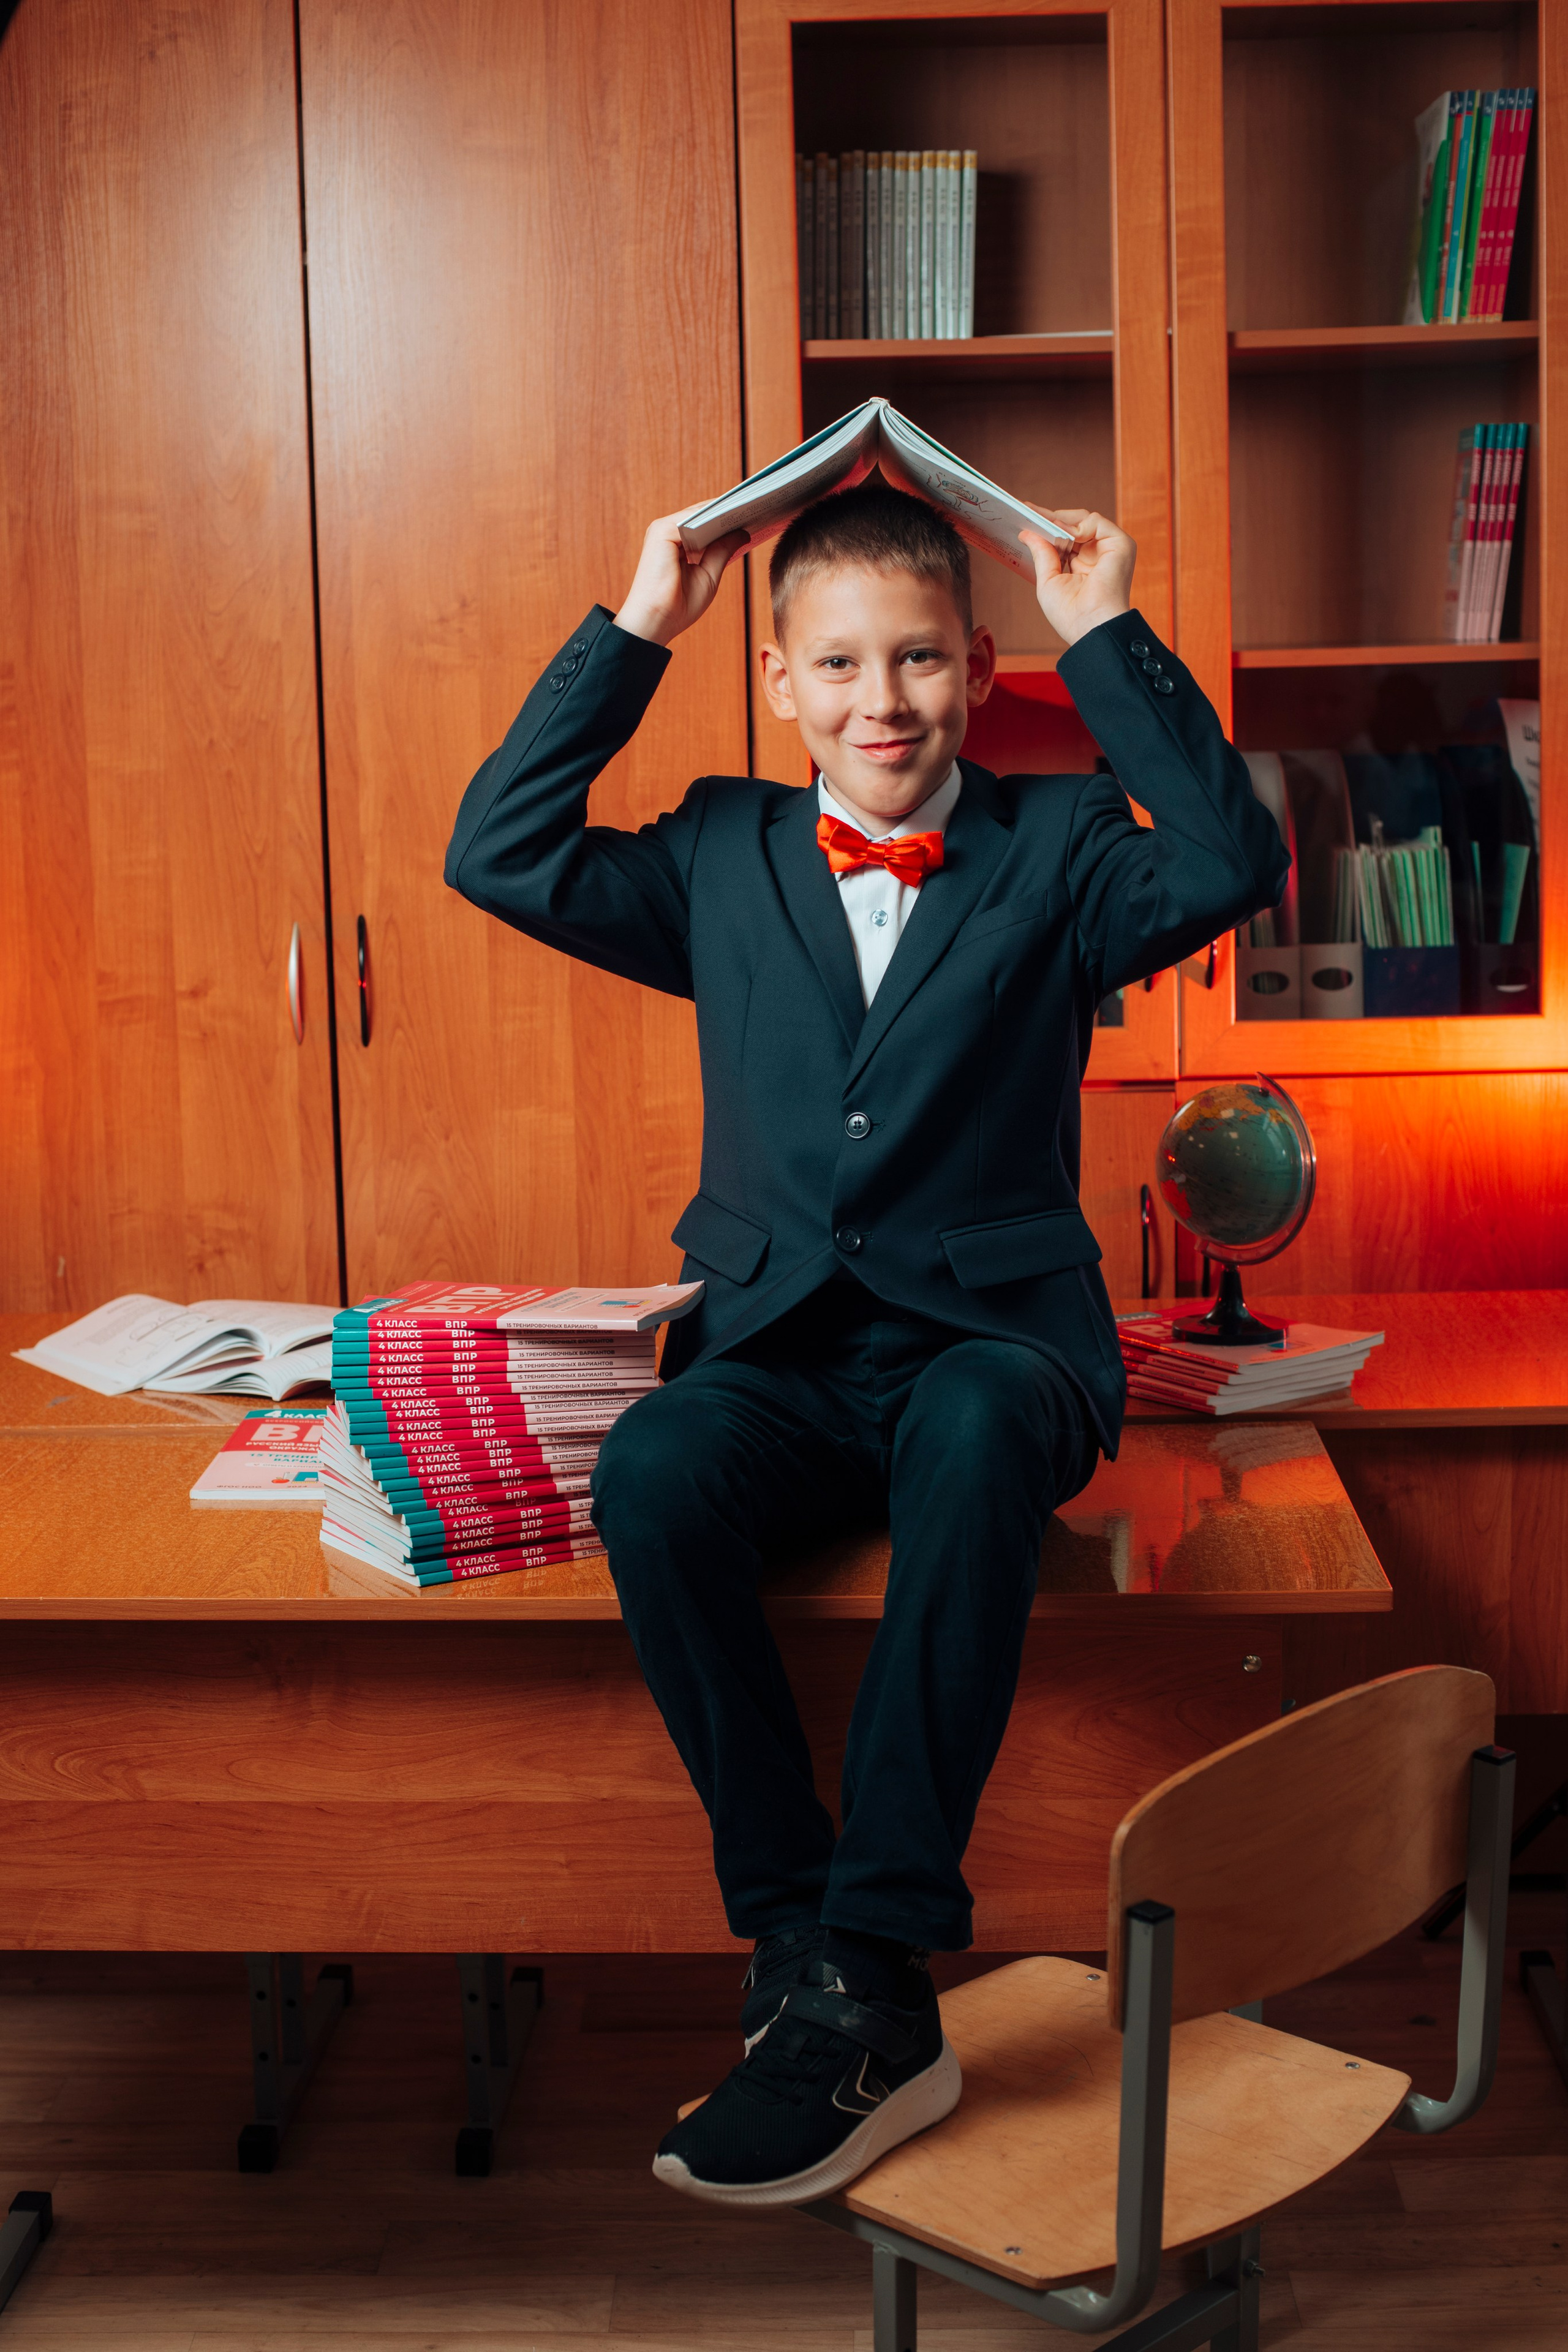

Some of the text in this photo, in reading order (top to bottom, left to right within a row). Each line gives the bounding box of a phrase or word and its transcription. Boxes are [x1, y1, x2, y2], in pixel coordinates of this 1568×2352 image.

[403, 1287, 516, 1313] ВПР
[388, 1354, 424, 1362] КЛАСС
[454, 1352, 477, 1361] ВПР
[387, 1377, 422, 1385] КЛАСС
[391, 1389, 427, 1397] КЛАСС
[401, 1400, 436, 1409] КЛАСС
[466, 1397, 489, 1406] ВПР
[405, 1409, 440, 1417] КЛАСС
[407, 1422, 442, 1430] КЛАСС
[408, 1432, 443, 1441] КЛАСС
[473, 1429, 496, 1438] ВПР
[421, 1444, 455, 1453] КЛАСС
[426, 1453, 460, 1463] КЛАСС
[489, 1449, 512, 1458] ВПР
[427, 1463, 461, 1473] КЛАСС
[490, 1458, 513, 1468] ВПР
[437, 1474, 470, 1484] КЛАСС
[499, 1469, 521, 1478] ВПР
[440, 1484, 474, 1494] КЛАСС
[502, 1479, 524, 1487] ВПР
[445, 1497, 478, 1507] КЛАСС
[506, 1491, 528, 1500] ВПР
[456, 1505, 488, 1515] КЛАСС
[461, 1516, 493, 1528] КЛАСС
[521, 1509, 541, 1518] ВПР
[462, 1527, 495, 1538] КЛАСС
[522, 1520, 543, 1529] ВПР
[461, 1539, 492, 1550] КЛАСС
[521, 1531, 541, 1540] ВПР
[464, 1555, 496, 1566] КЛАСС
[522, 1548, 543, 1558] ВПР
[469, 1564, 500, 1575] КЛАСС
[526, 1556, 547, 1566] ВПР
